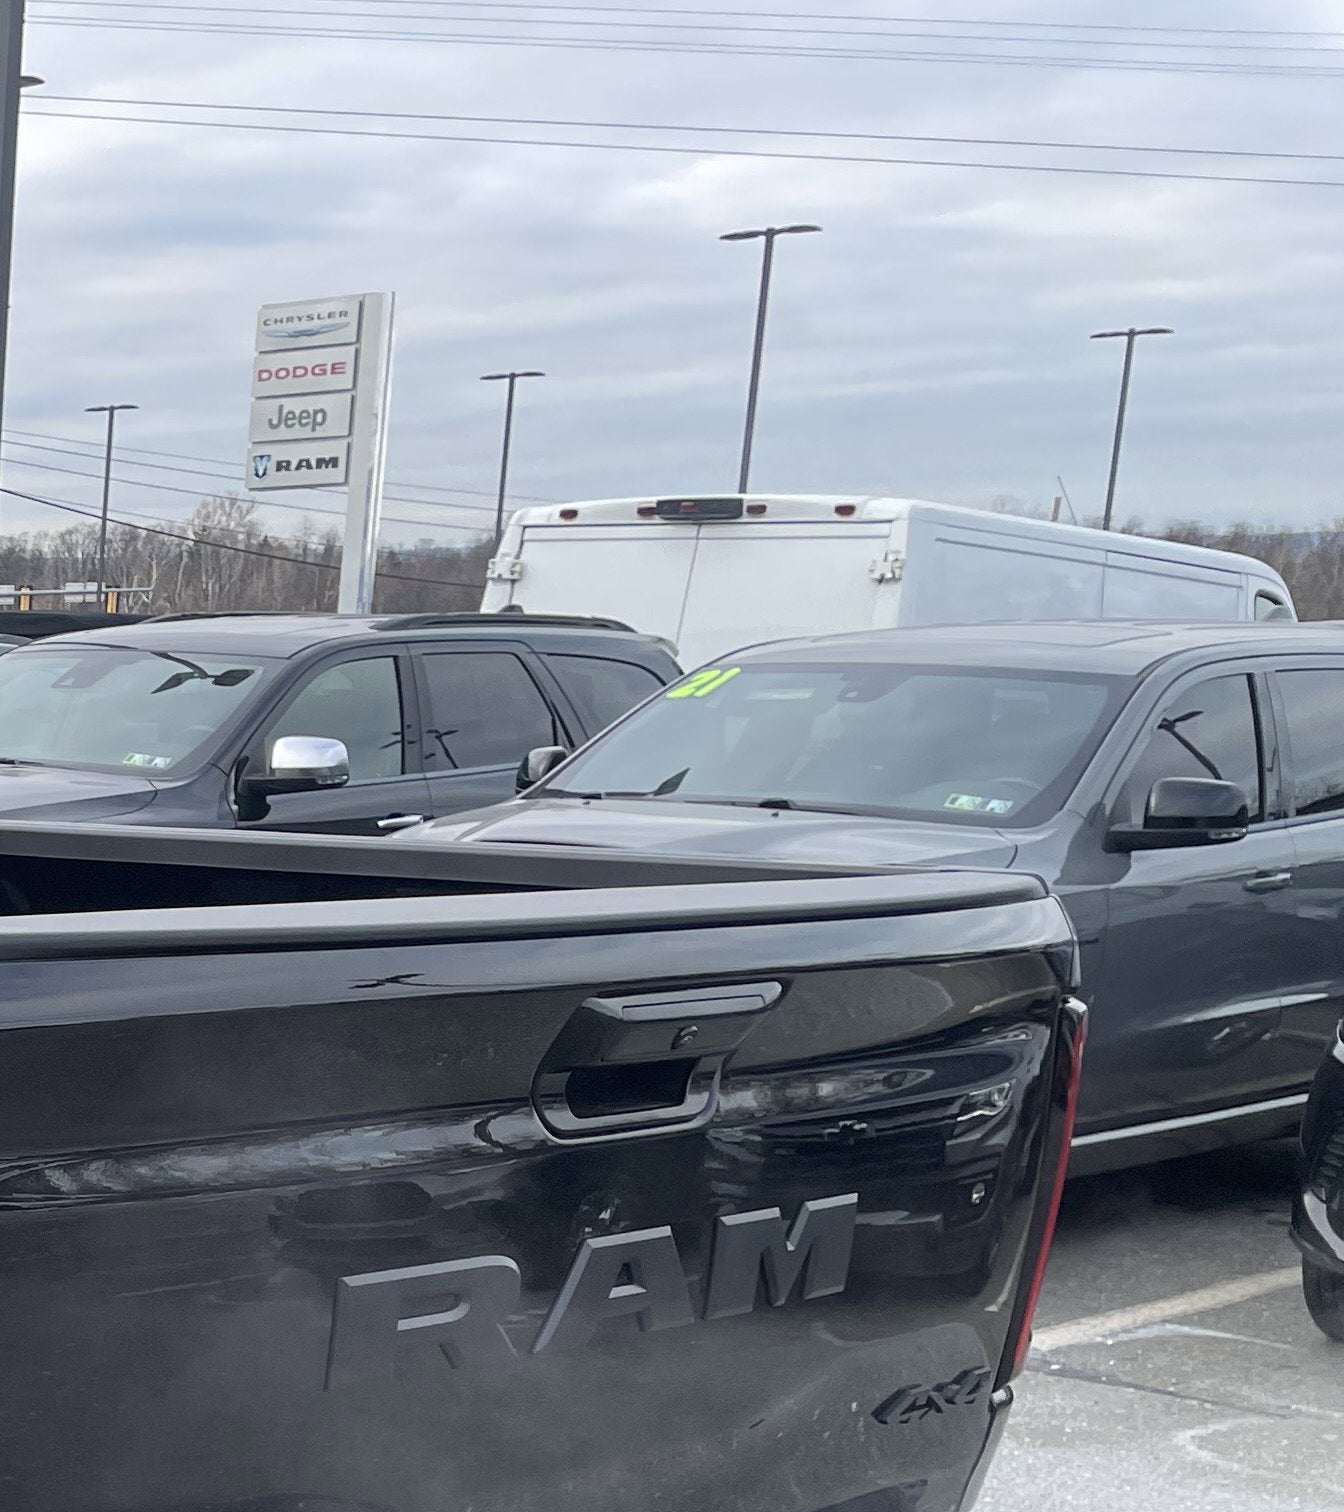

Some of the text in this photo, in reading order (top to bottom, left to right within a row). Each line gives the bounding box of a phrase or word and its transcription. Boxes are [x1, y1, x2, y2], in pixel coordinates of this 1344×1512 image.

[263, 310, 349, 326] CHRYSLER
[257, 361, 348, 382] DODGE
[268, 404, 327, 432] Jeep
[275, 456, 339, 473] RAM
[665, 666, 742, 699] 21
[322, 1192, 859, 1394] RAM
